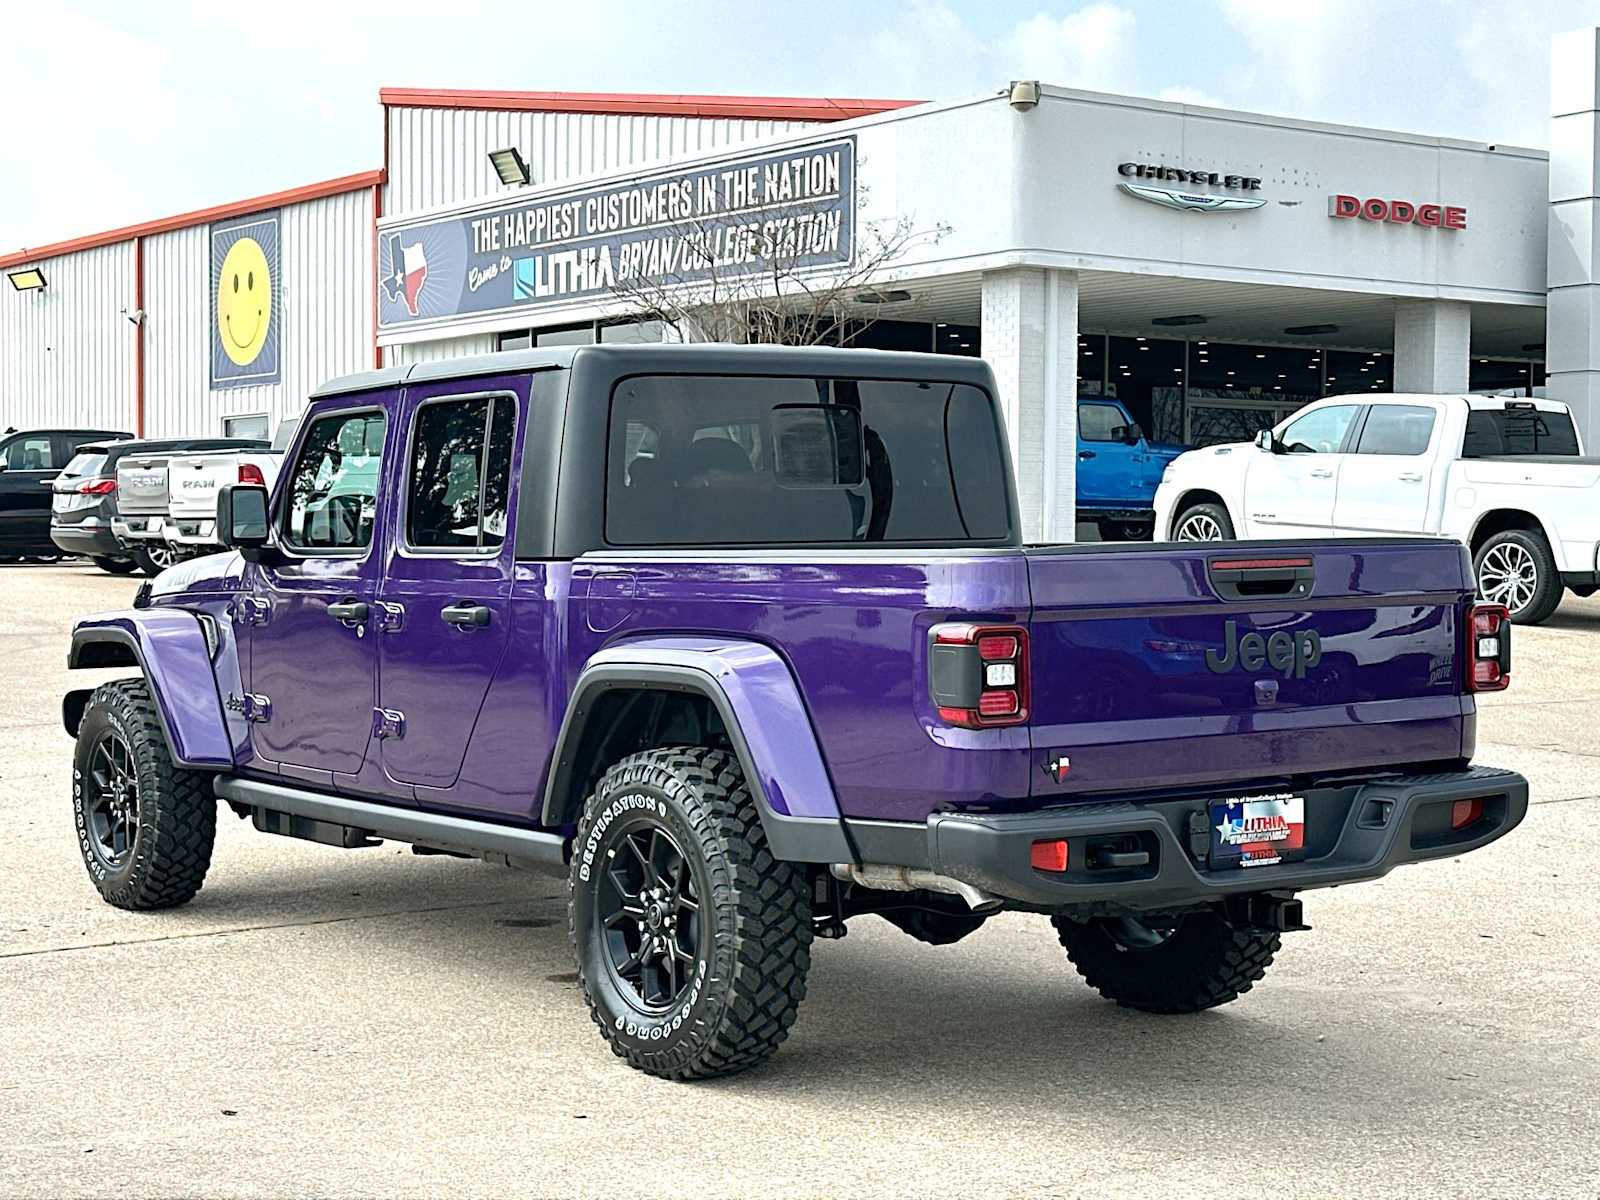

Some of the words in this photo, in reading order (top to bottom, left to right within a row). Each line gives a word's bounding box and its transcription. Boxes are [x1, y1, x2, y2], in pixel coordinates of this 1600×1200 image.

[1118, 162, 1262, 190] CHRYSLER
[472, 216, 500, 253] THE
[504, 201, 582, 248] HAPPIEST
[586, 179, 692, 233] CUSTOMERS
[698, 175, 717, 213] IN
[721, 167, 759, 209] THE
[765, 151, 839, 202] NATION
[1328, 194, 1467, 230] DODGE
[535, 245, 615, 297] LITHIA
[762, 210, 841, 260] STATION
[469, 261, 498, 292] Come
[500, 255, 512, 273] to
[183, 480, 215, 489] RAM
[1206, 620, 1321, 679] Jeep
[579, 794, 656, 882] DESTINATION
[1244, 816, 1287, 832] LITHIA
